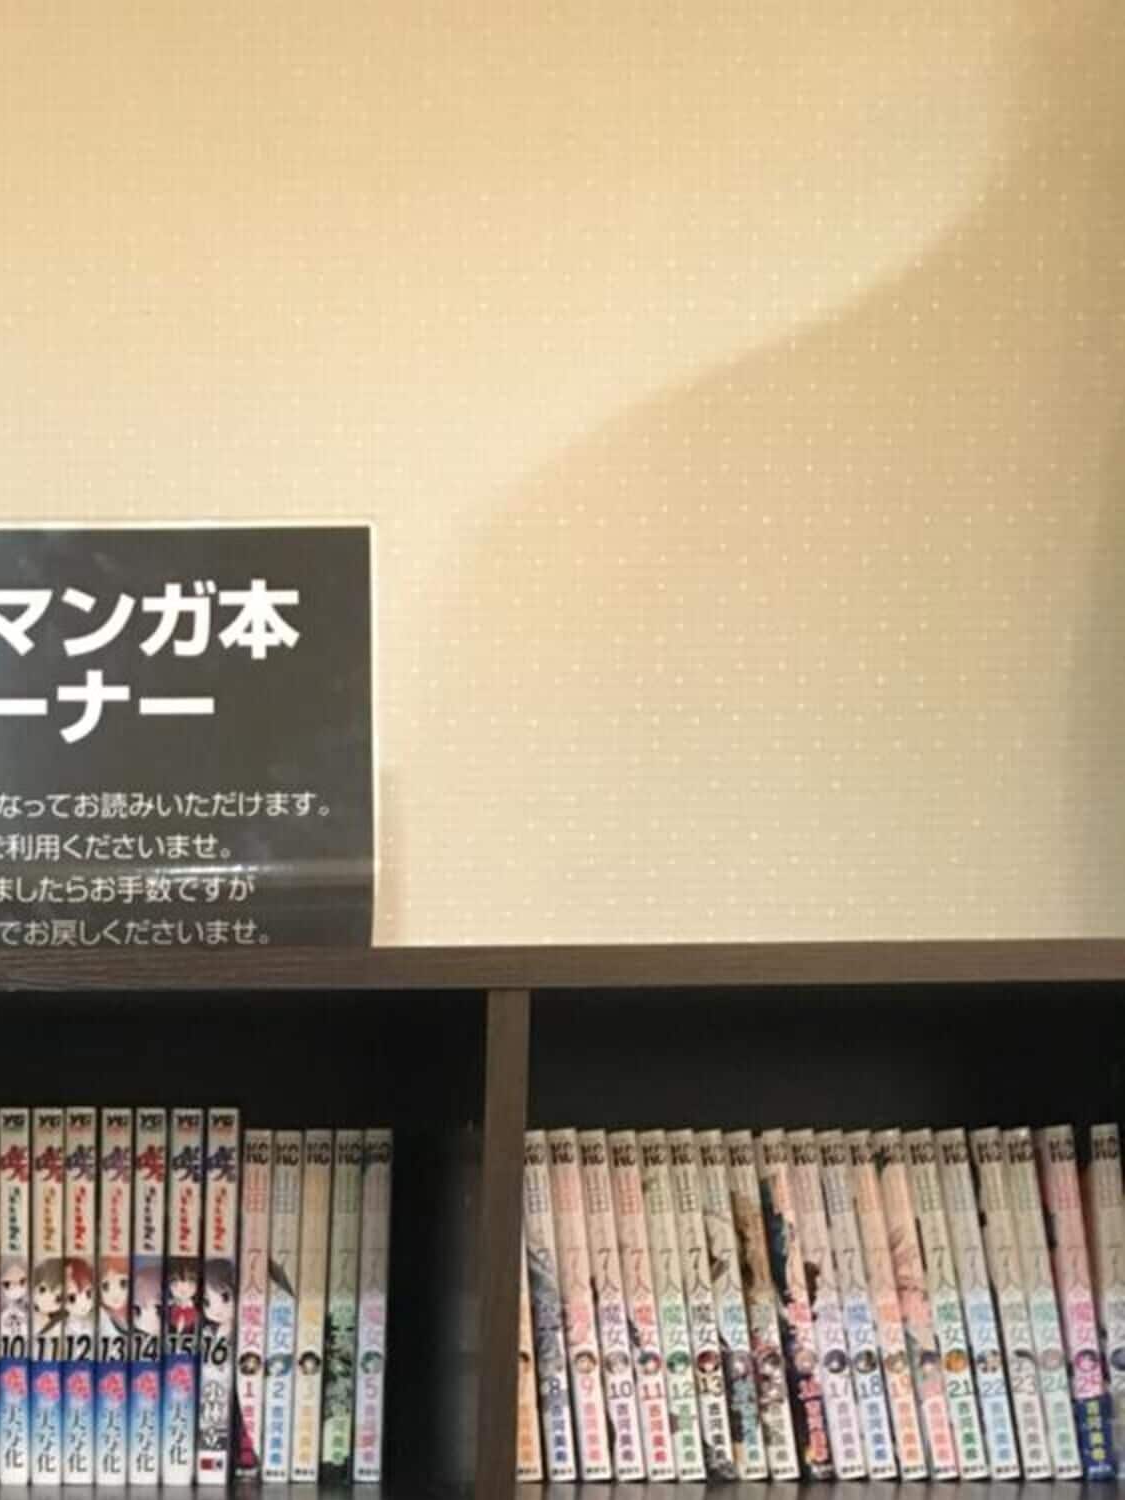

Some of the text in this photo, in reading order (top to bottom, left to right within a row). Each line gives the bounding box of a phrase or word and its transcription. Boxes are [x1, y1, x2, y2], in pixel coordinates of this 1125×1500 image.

[2, 1335, 25, 1360] 10
[37, 1336, 59, 1361] 11
[66, 1334, 92, 1360] 12
[101, 1336, 125, 1361] 13
[134, 1336, 158, 1361] 14
[169, 1336, 193, 1354] 15
[203, 1336, 228, 1365] 16
[274, 1382, 285, 1398] 2
[611, 1381, 633, 1398] 10
[643, 1382, 665, 1400] 11
[672, 1382, 693, 1398] 12
[949, 1380, 972, 1397] 21
[982, 1381, 1005, 1397] 22
